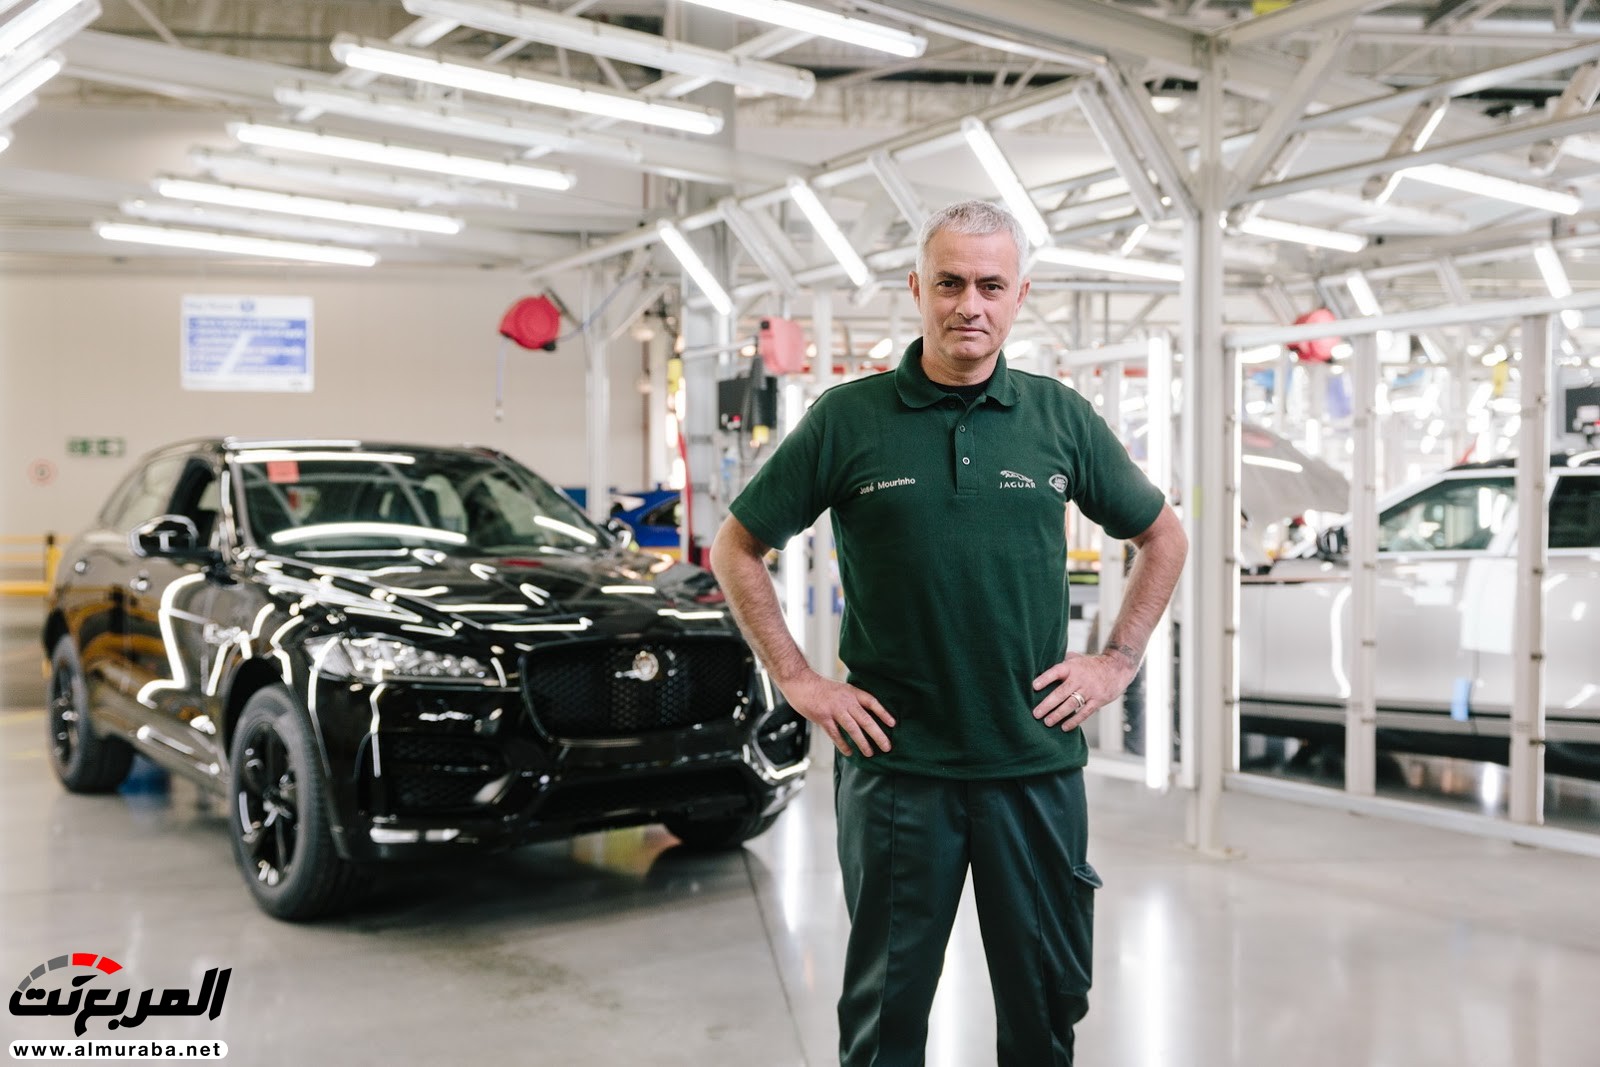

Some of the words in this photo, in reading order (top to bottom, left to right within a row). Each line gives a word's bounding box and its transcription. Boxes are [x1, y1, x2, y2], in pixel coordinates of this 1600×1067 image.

[860, 482, 875, 494] José
[878, 477, 916, 490] Mourinho
[999, 481, 1036, 489] JAGUAR
